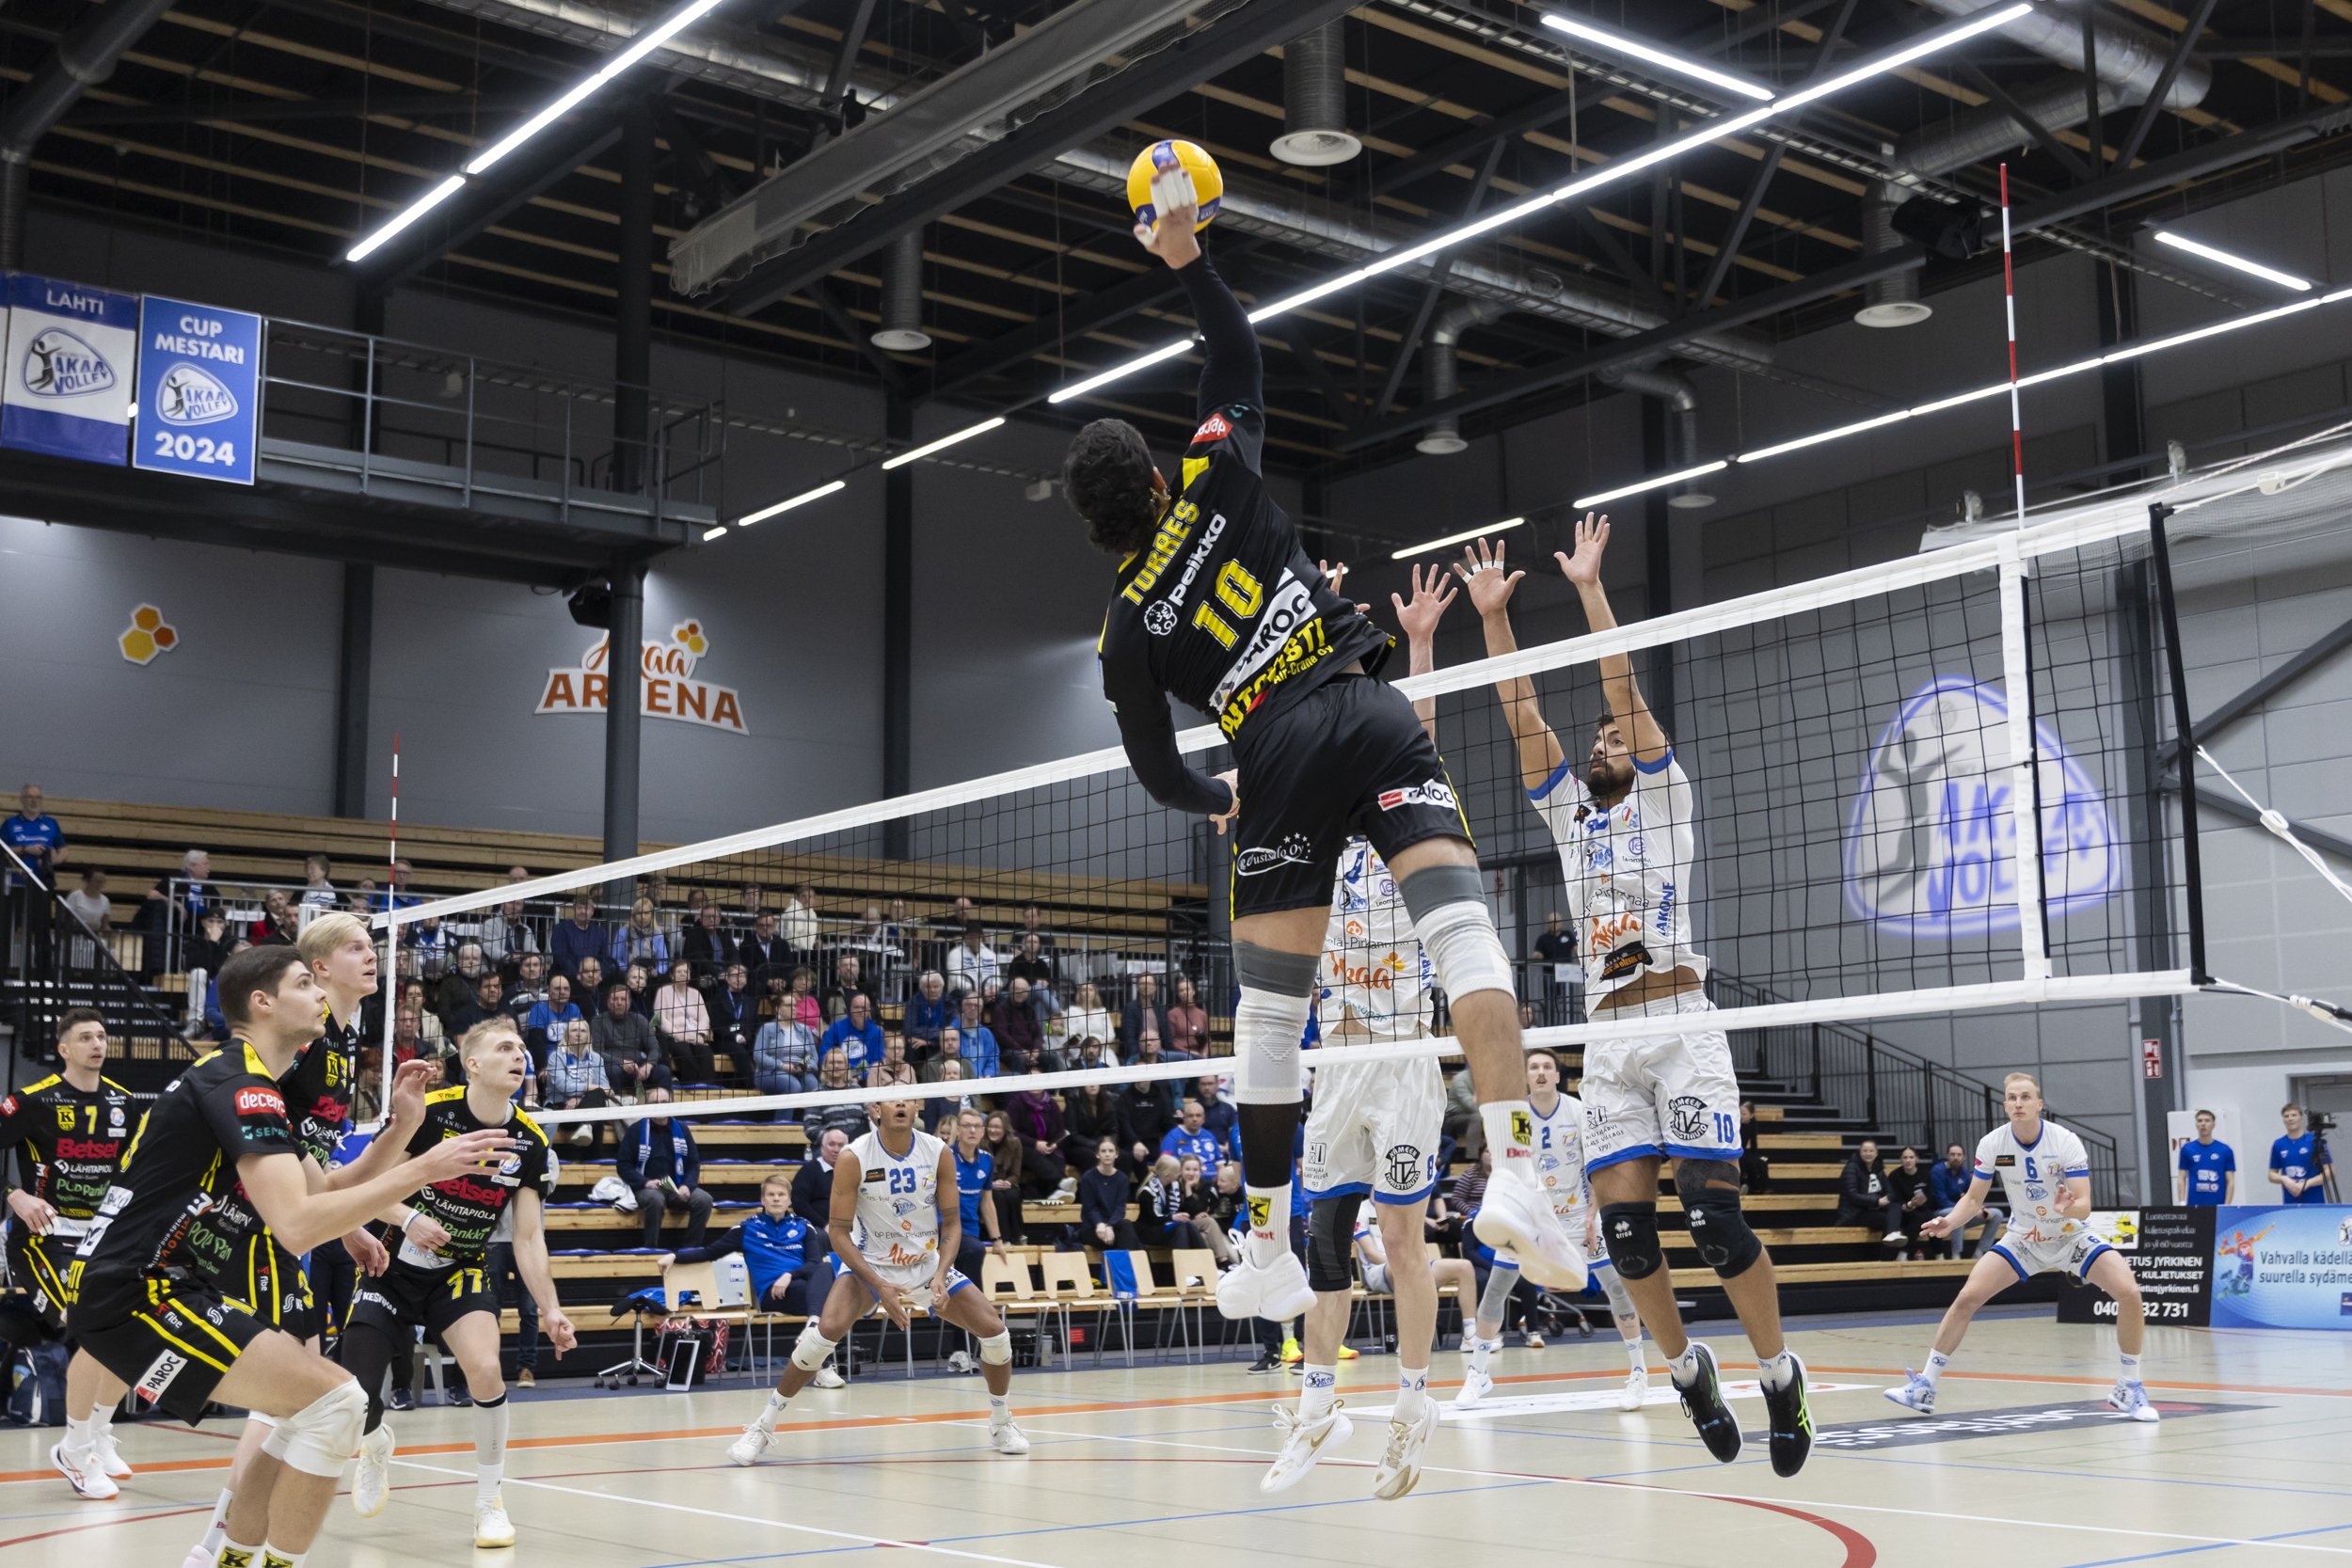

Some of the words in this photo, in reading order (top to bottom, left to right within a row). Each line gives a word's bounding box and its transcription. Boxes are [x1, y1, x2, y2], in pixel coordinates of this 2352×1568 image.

[47, 289, 103, 315] LAHTI
[180, 315, 223, 338] CUP
[154, 332, 245, 364] MESTARI
[55, 356, 104, 374] AKAA
[54, 370, 107, 393] VOLLEY
[184, 388, 225, 404] AKAA
[184, 400, 228, 419] VOLLEY
[154, 430, 235, 467] 2024
[1168, 514, 1227, 607] peikko
[1192, 558, 1263, 651] 10
[543, 673, 742, 729] ARENA
[1937, 782, 2086, 845] AKA
[1927, 829, 2094, 919] VOLEY
[85, 1105, 98, 1134] 7
[1713, 1113, 1735, 1144] 10
[1541, 1127, 1551, 1149] 2
[1427, 1154, 1434, 1181] 8
[2025, 1156, 2039, 1180] 6
[889, 1167, 917, 1195] 23
[436, 1198, 496, 1221] LÄHITAPIOLA
[2087, 1235, 2101, 1243] 6
[2153, 1256, 2202, 1268] JYRKINEN
[2260, 1251, 2309, 1265] Vahvalla
[2141, 1271, 2204, 1279] KULJETUKSET
[2259, 1270, 2306, 1283] suurella
[2162, 1302, 2188, 1317] 731
[147, 1354, 182, 1390] PAROC
